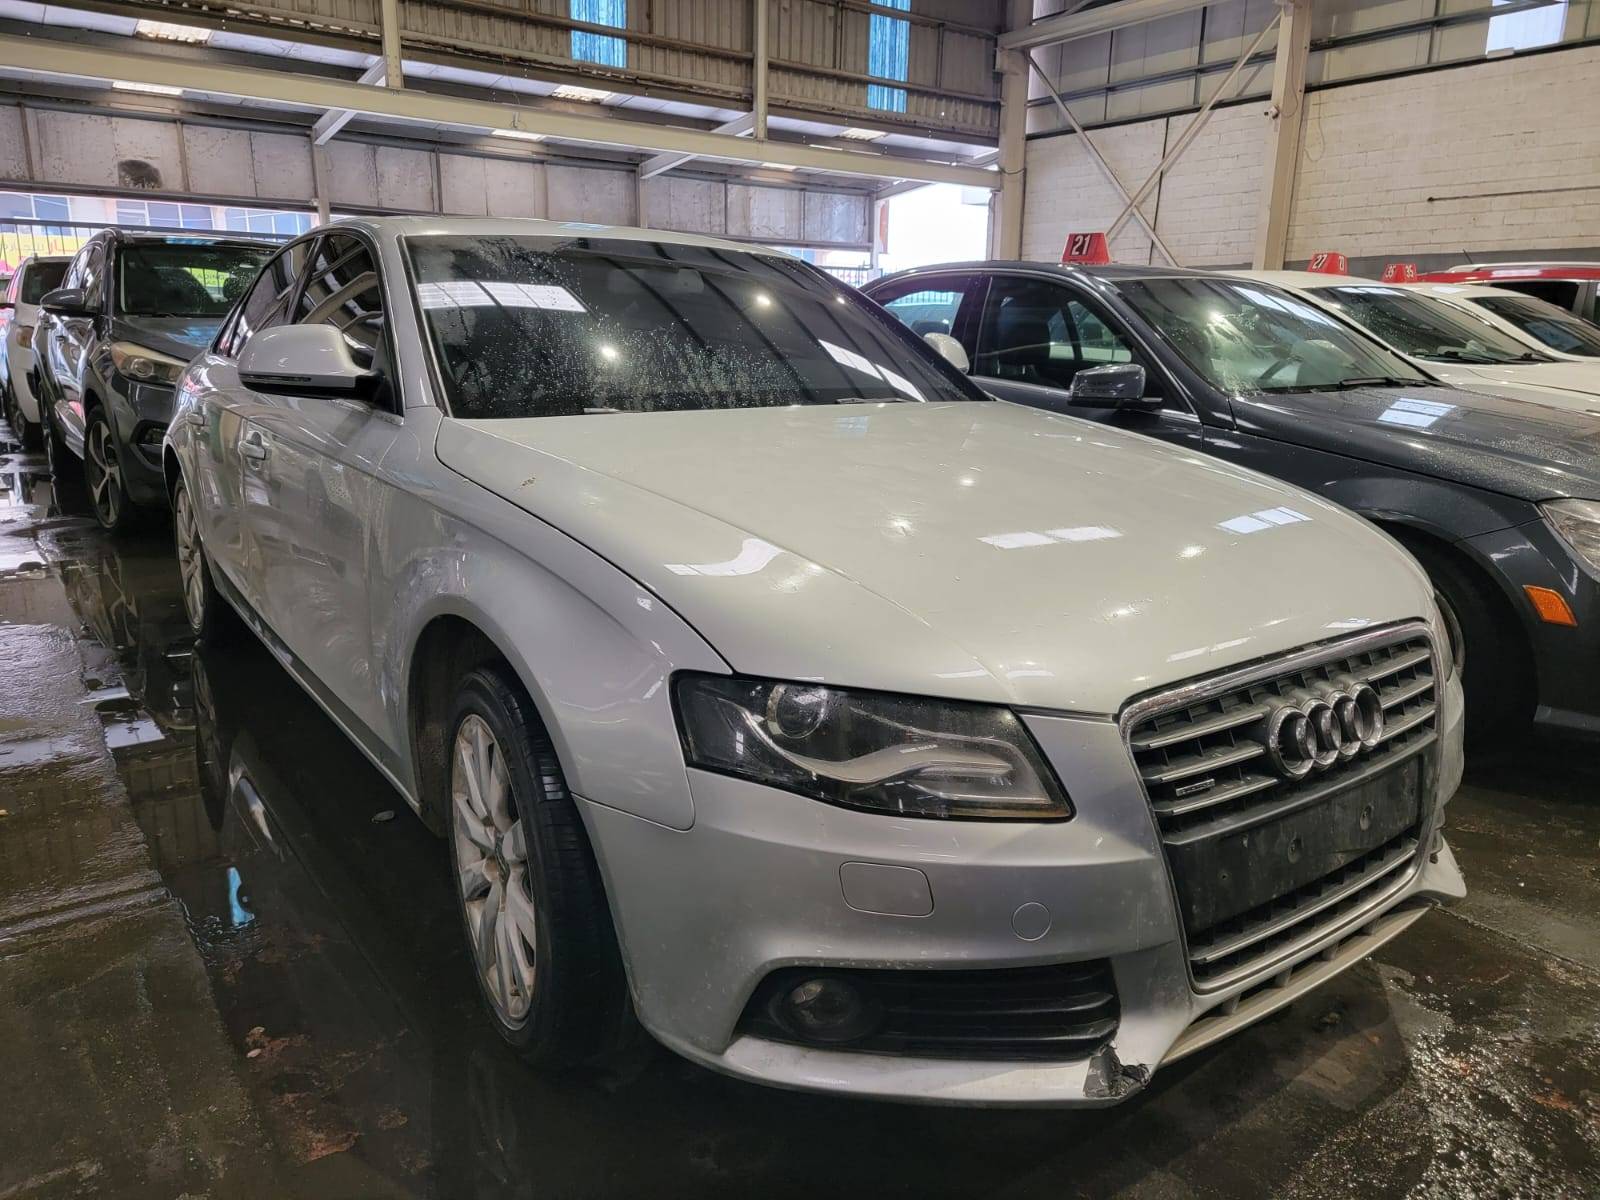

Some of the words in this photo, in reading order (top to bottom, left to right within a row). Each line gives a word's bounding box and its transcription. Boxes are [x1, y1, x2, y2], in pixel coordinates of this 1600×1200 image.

[1071, 235, 1091, 255] 21
[1312, 254, 1328, 269] 27
[1405, 265, 1414, 279] 35
